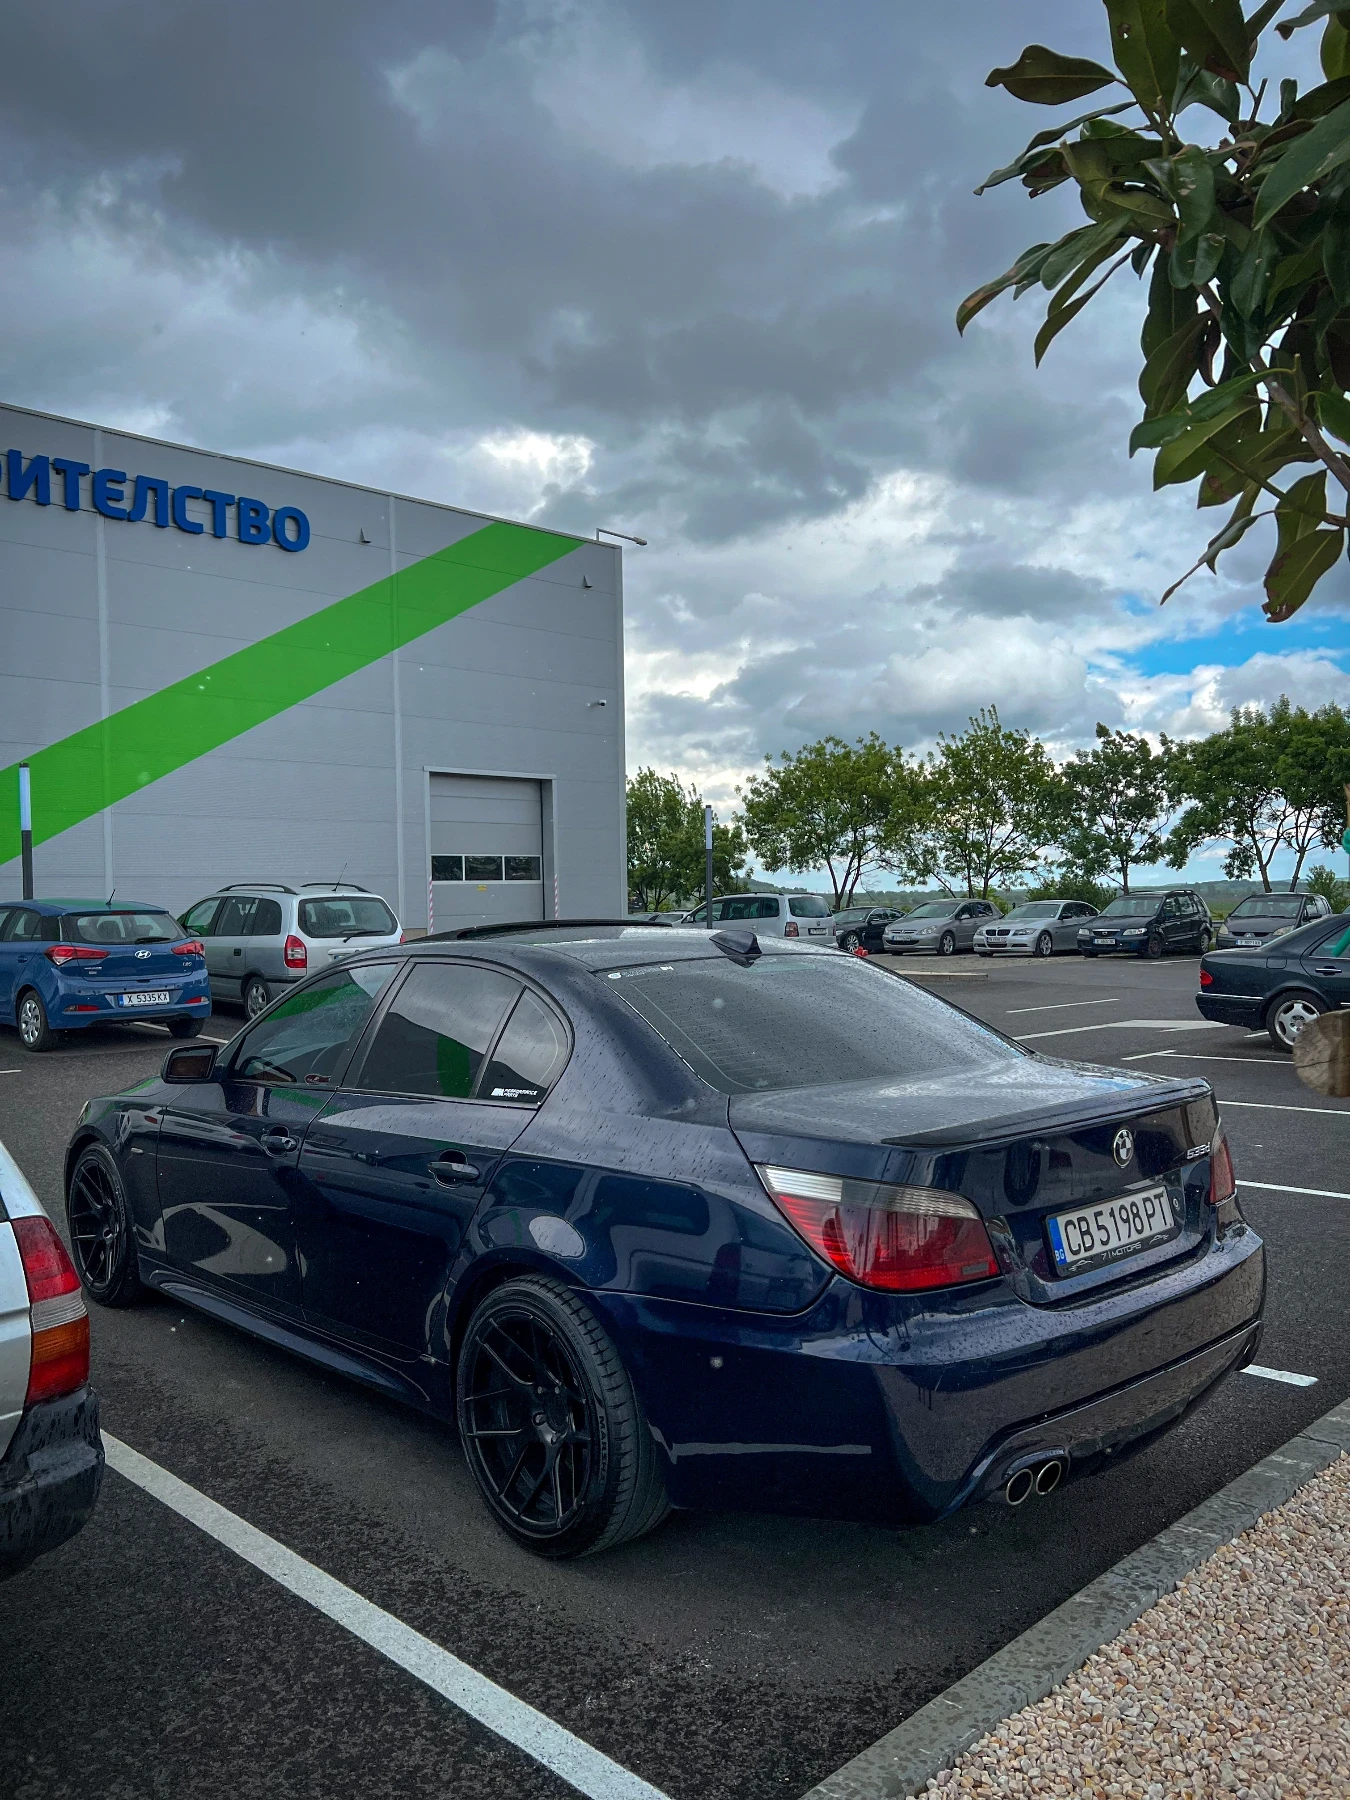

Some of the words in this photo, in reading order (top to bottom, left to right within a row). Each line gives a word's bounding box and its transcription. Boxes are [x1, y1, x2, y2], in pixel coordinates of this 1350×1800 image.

[0, 449, 310, 552] ИТЕЛСТВО
[137, 992, 168, 1003] 5335KX
[1186, 1142, 1211, 1159] 535d
[1055, 1249, 1065, 1260] BG
